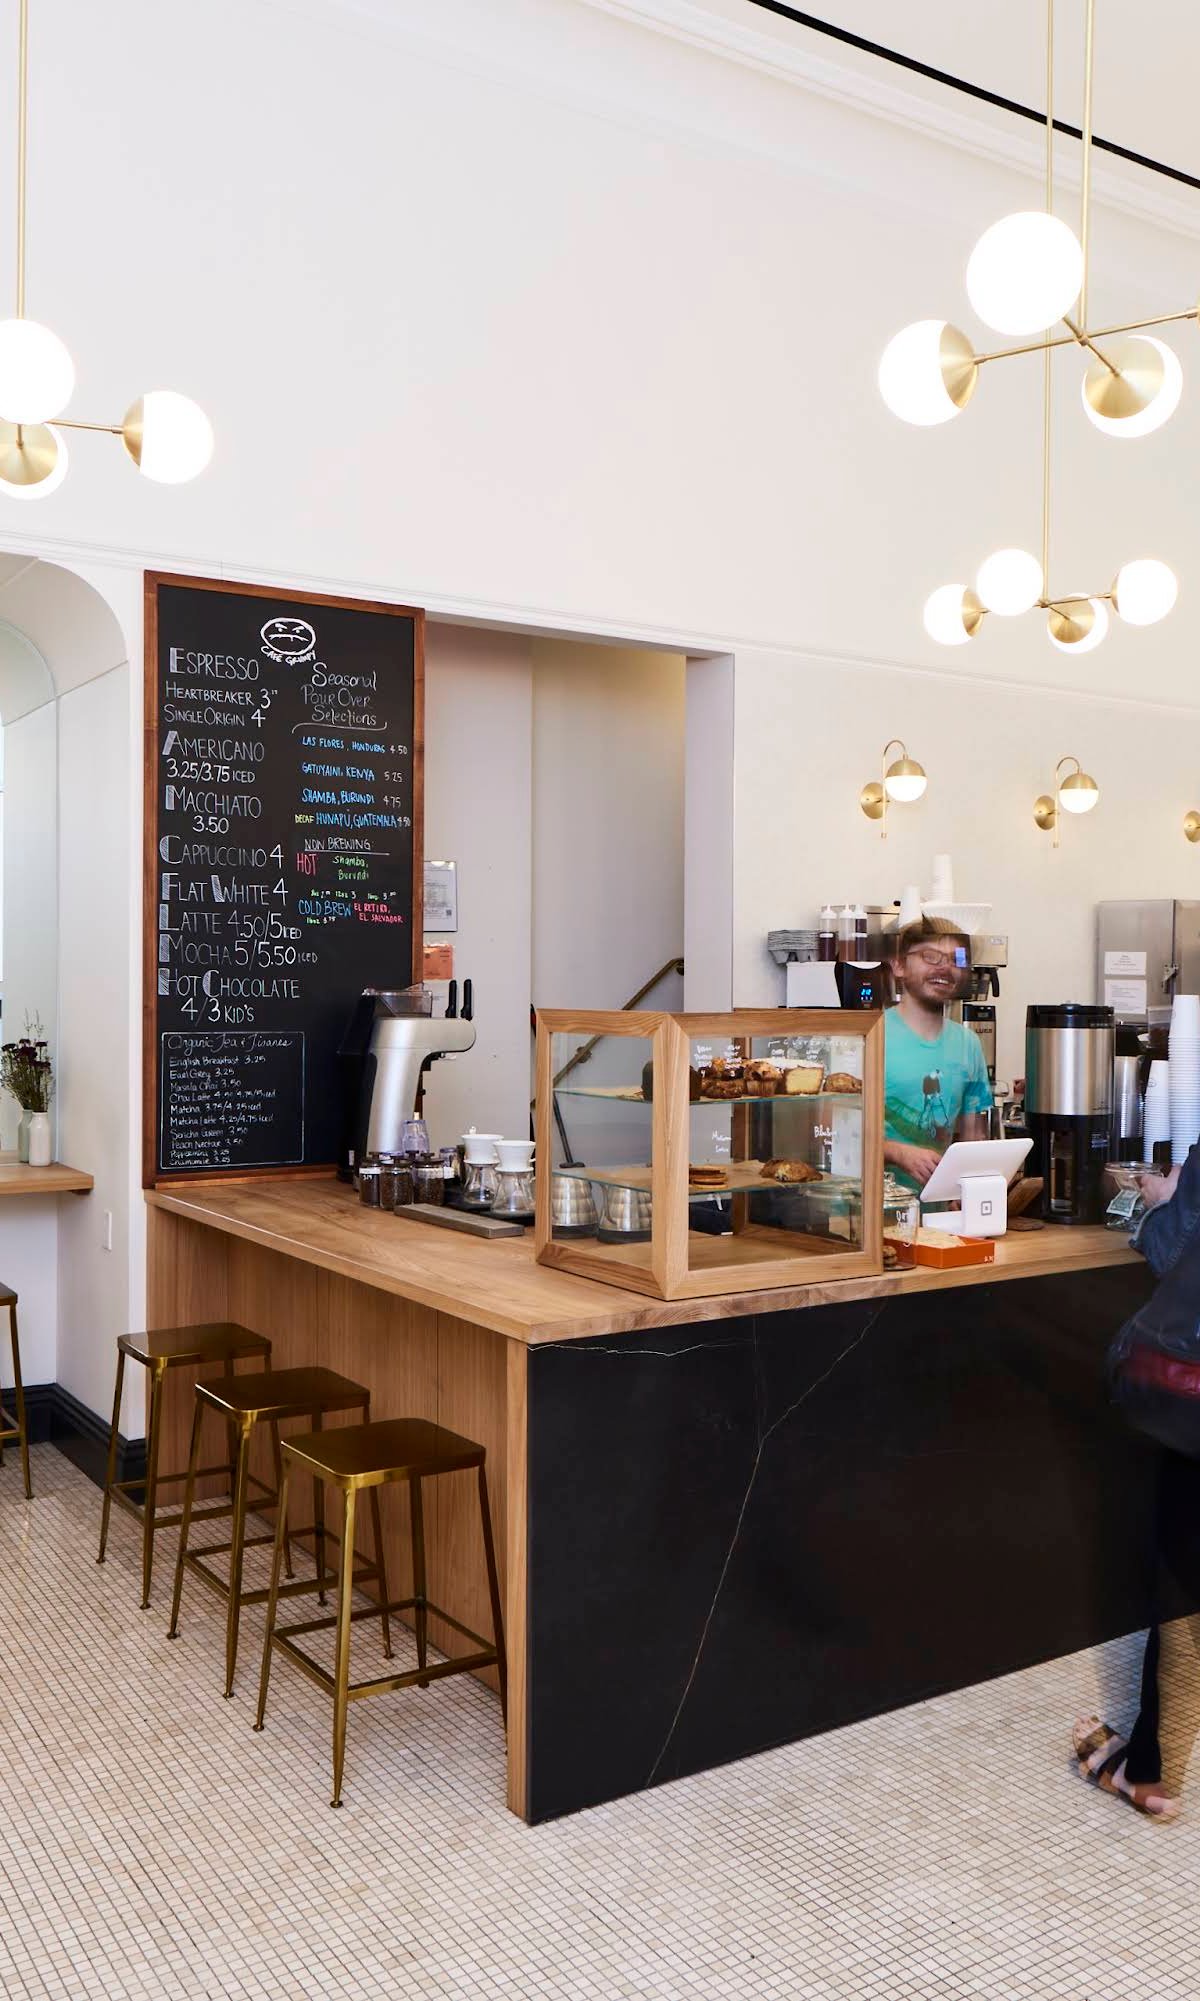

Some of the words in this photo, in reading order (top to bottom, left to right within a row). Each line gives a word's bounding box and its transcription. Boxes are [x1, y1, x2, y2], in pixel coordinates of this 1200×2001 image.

[169, 647, 259, 680] ESPRESSO
[311, 661, 377, 691] Seasonal
[165, 680, 255, 706] HEARTBREAKER
[251, 708, 266, 728] 4
[311, 704, 377, 726] Selections
[162, 730, 265, 762] AMERICANO
[302, 736, 317, 746] LAS
[352, 741, 386, 754] HONDURAS
[166, 758, 230, 783] 3.25/3.75
[232, 770, 256, 783] ICED
[345, 765, 375, 782] KENYA
[165, 784, 262, 818] MACCHIATO
[340, 790, 375, 805] BURUNDI
[192, 815, 229, 834] 3.50
[294, 813, 315, 824] DECAF
[353, 813, 397, 828] GUATEMALA
[159, 835, 267, 868] CAPPUCCINO
[269, 843, 285, 869] 4
[296, 852, 317, 876] HOT
[161, 872, 208, 902] FLAT
[210, 874, 269, 906] WHITE
[272, 877, 289, 907] 4
[298, 899, 322, 916] COLD
[324, 900, 352, 917] BREW
[359, 912, 369, 921] EL
[159, 903, 222, 935] LATTE
[227, 909, 283, 941] 4.50/5
[283, 925, 302, 939] ICED
[159, 933, 232, 965] MOCHA
[234, 939, 296, 971] 5/5.50
[158, 967, 202, 997] HOT
[202, 969, 300, 998] CHOCOLATE
[180, 997, 221, 1027] 4/3
[224, 1003, 255, 1024] KID'S
[168, 1035, 213, 1056] Organic
[210, 1033, 237, 1053] Tea
[169, 1056, 201, 1069] English
[202, 1055, 239, 1065] Breakfast
[244, 1055, 266, 1064] 3.25
